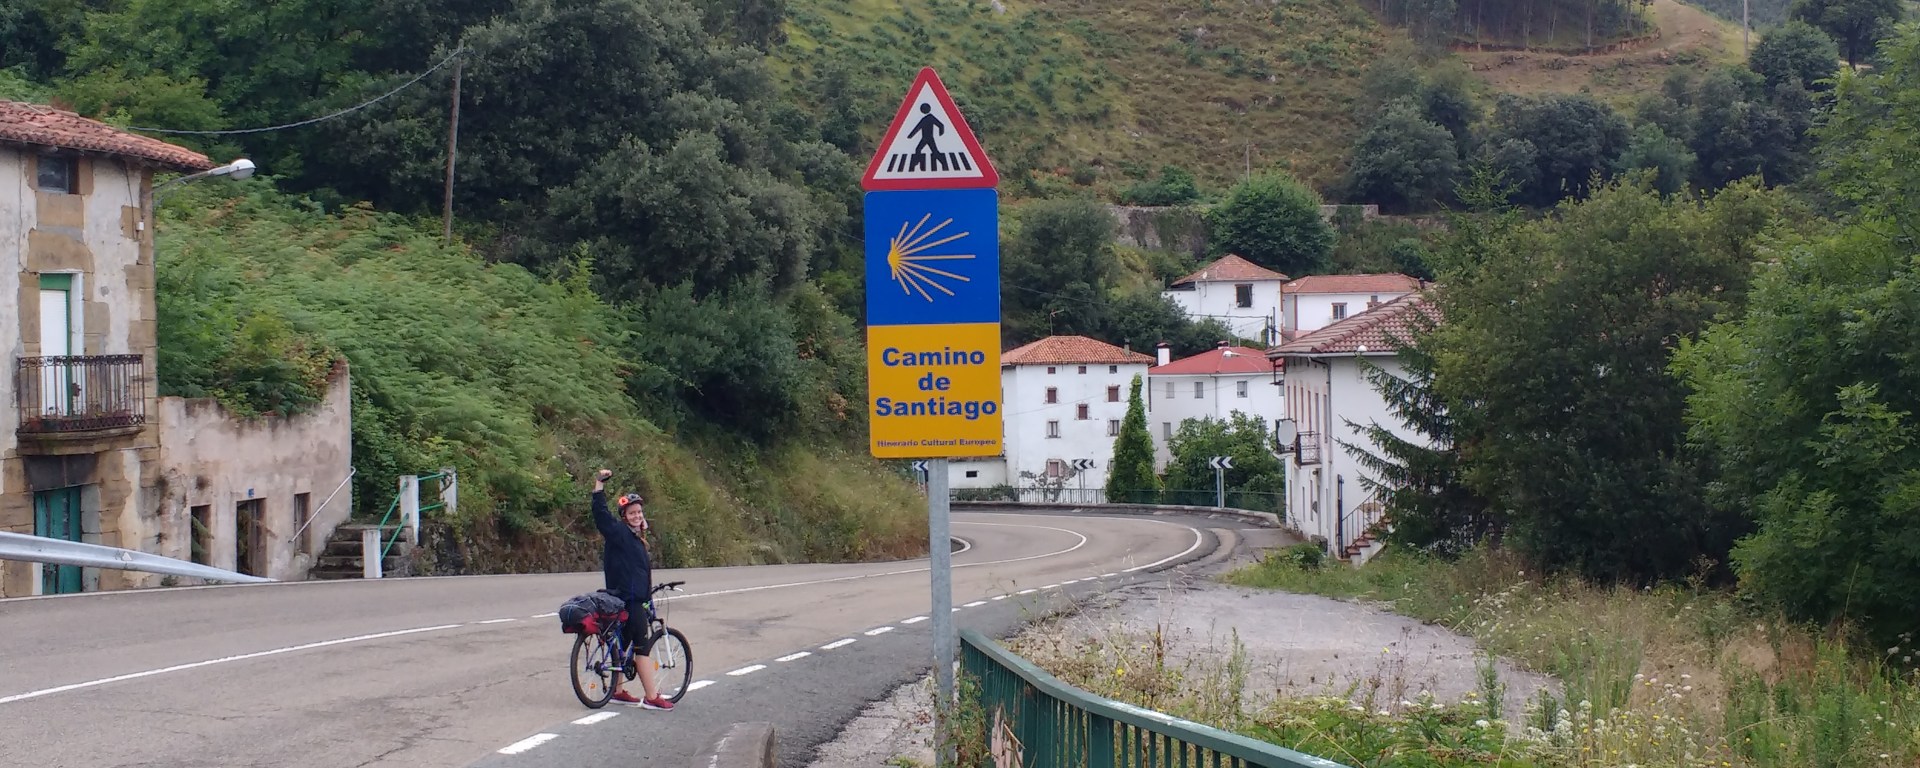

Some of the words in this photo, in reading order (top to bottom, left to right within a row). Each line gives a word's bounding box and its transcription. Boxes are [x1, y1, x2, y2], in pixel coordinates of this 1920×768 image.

[882, 347, 985, 367] Camino
[918, 372, 951, 391] de
[875, 397, 997, 420] Santiago
[877, 439, 918, 448] Itinerario
[921, 438, 956, 447] Cultural
[959, 438, 997, 447] Europeo
